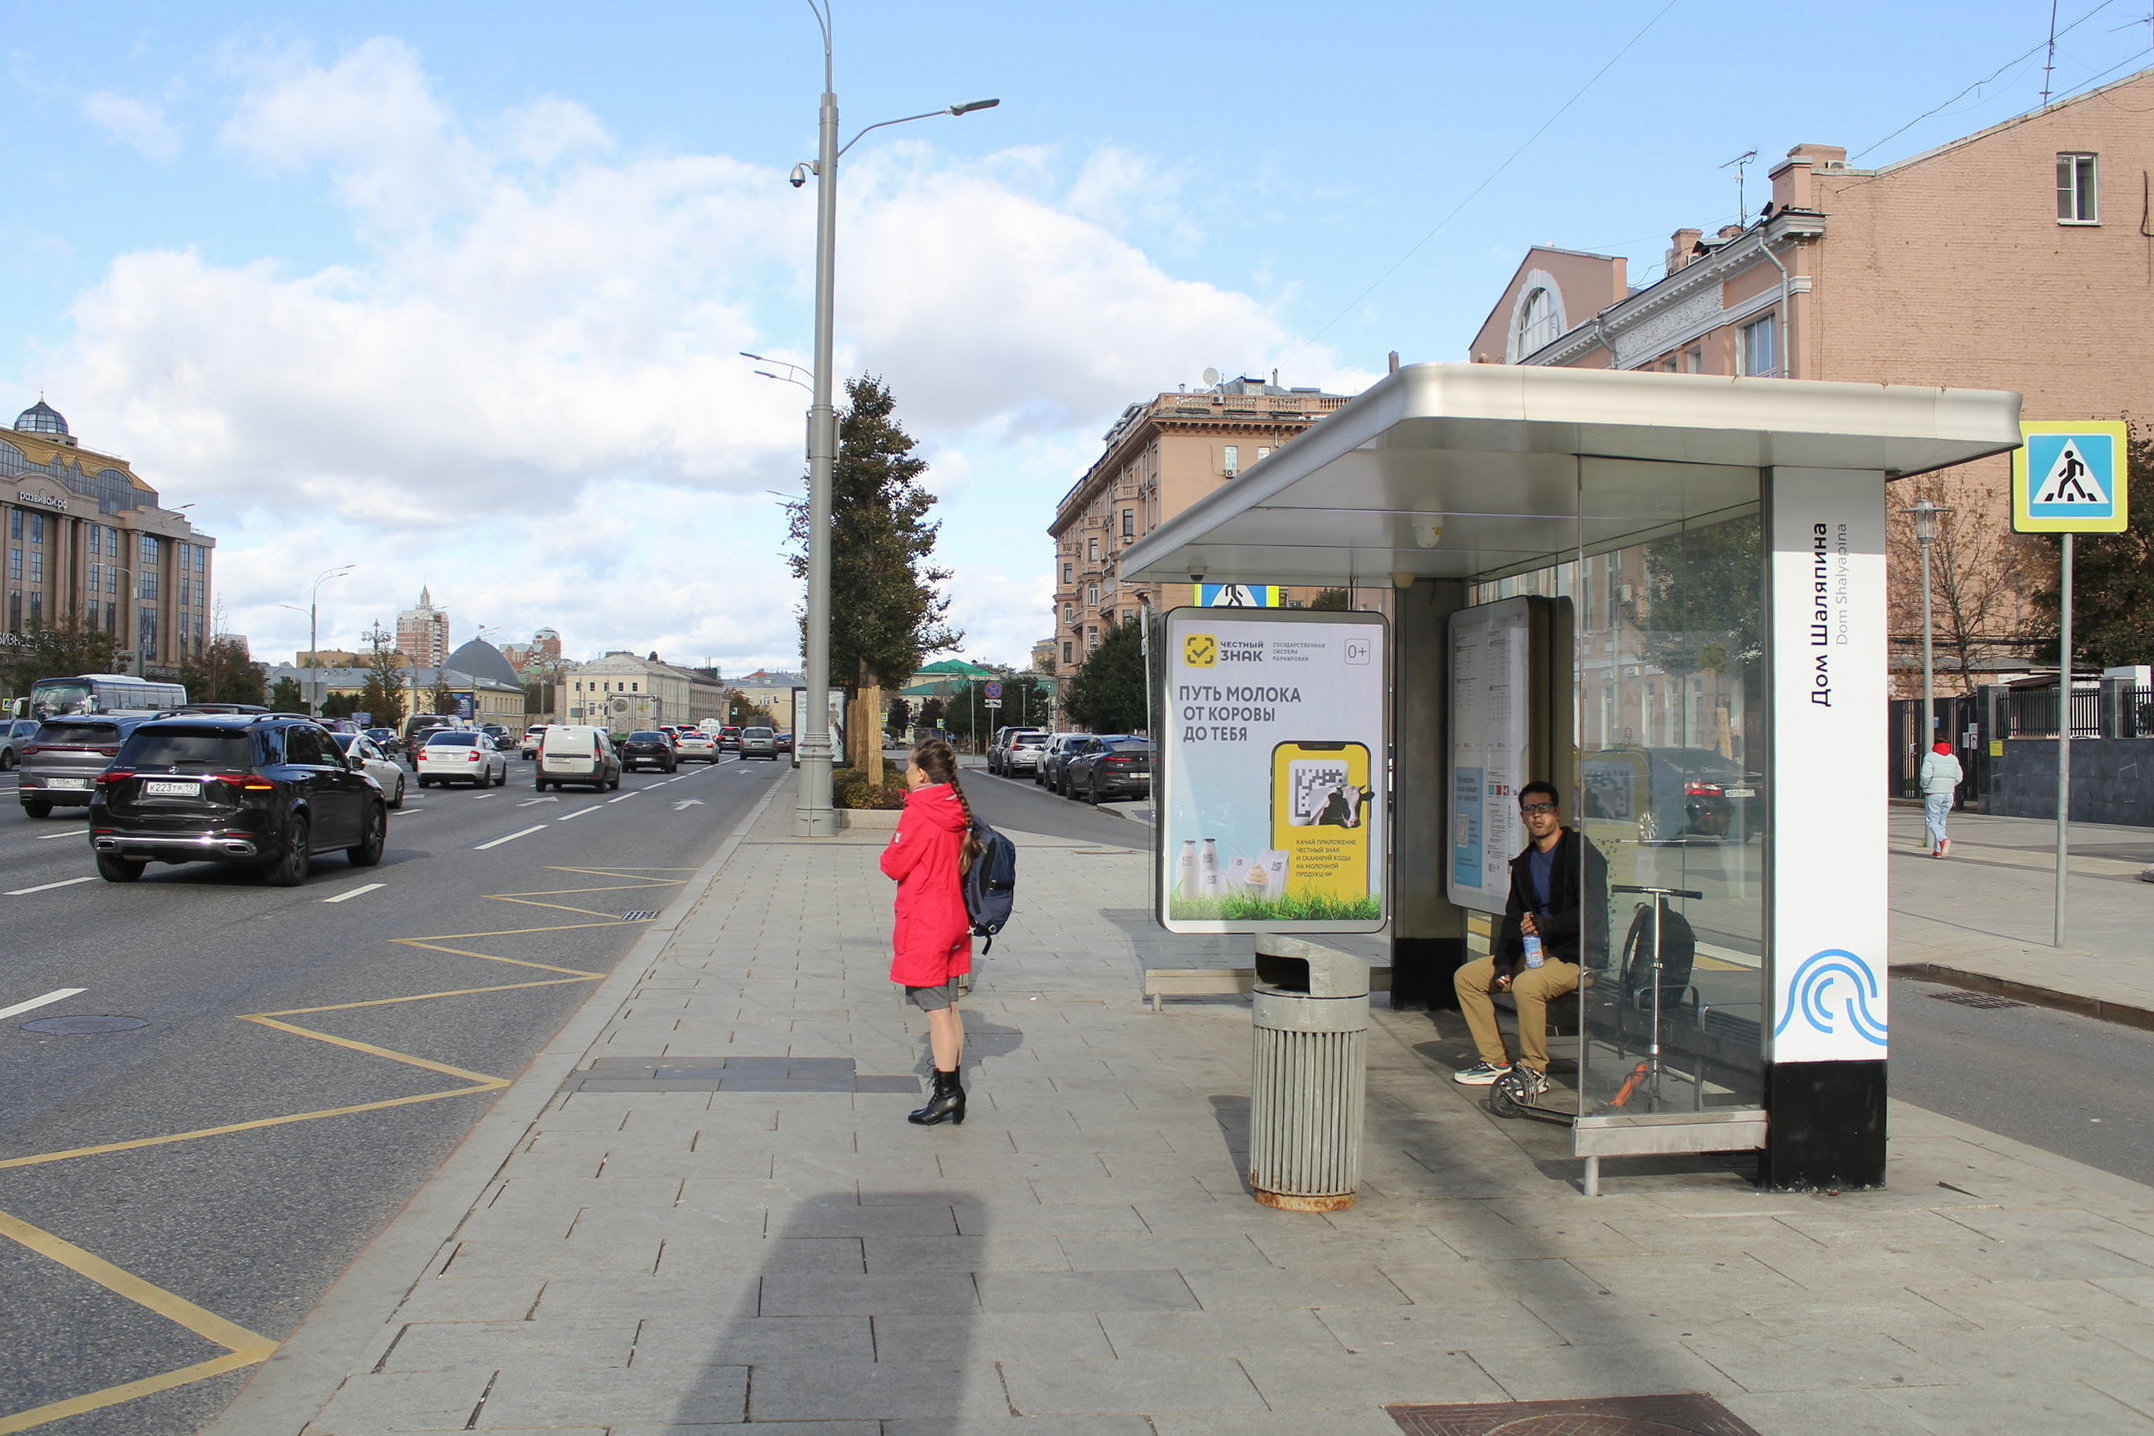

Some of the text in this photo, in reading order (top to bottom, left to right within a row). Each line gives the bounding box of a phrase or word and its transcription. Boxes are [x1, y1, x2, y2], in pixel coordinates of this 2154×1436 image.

[20, 491, 69, 511] развивай.рф
[1834, 523, 1850, 646] Dom Shalyapina
[1811, 522, 1831, 707] Дом Шаляпина
[1220, 640, 1264, 649] ЧЕСТНЫЙ
[1347, 644, 1367, 659] 0+
[1220, 650, 1263, 662] ЗНАК
[1179, 685, 1302, 703] ПУТЬ МОЛОКА
[1183, 706, 1275, 722] ОТ КОРОВЫ
[1183, 726, 1248, 743] ДО ТЕБЯ
